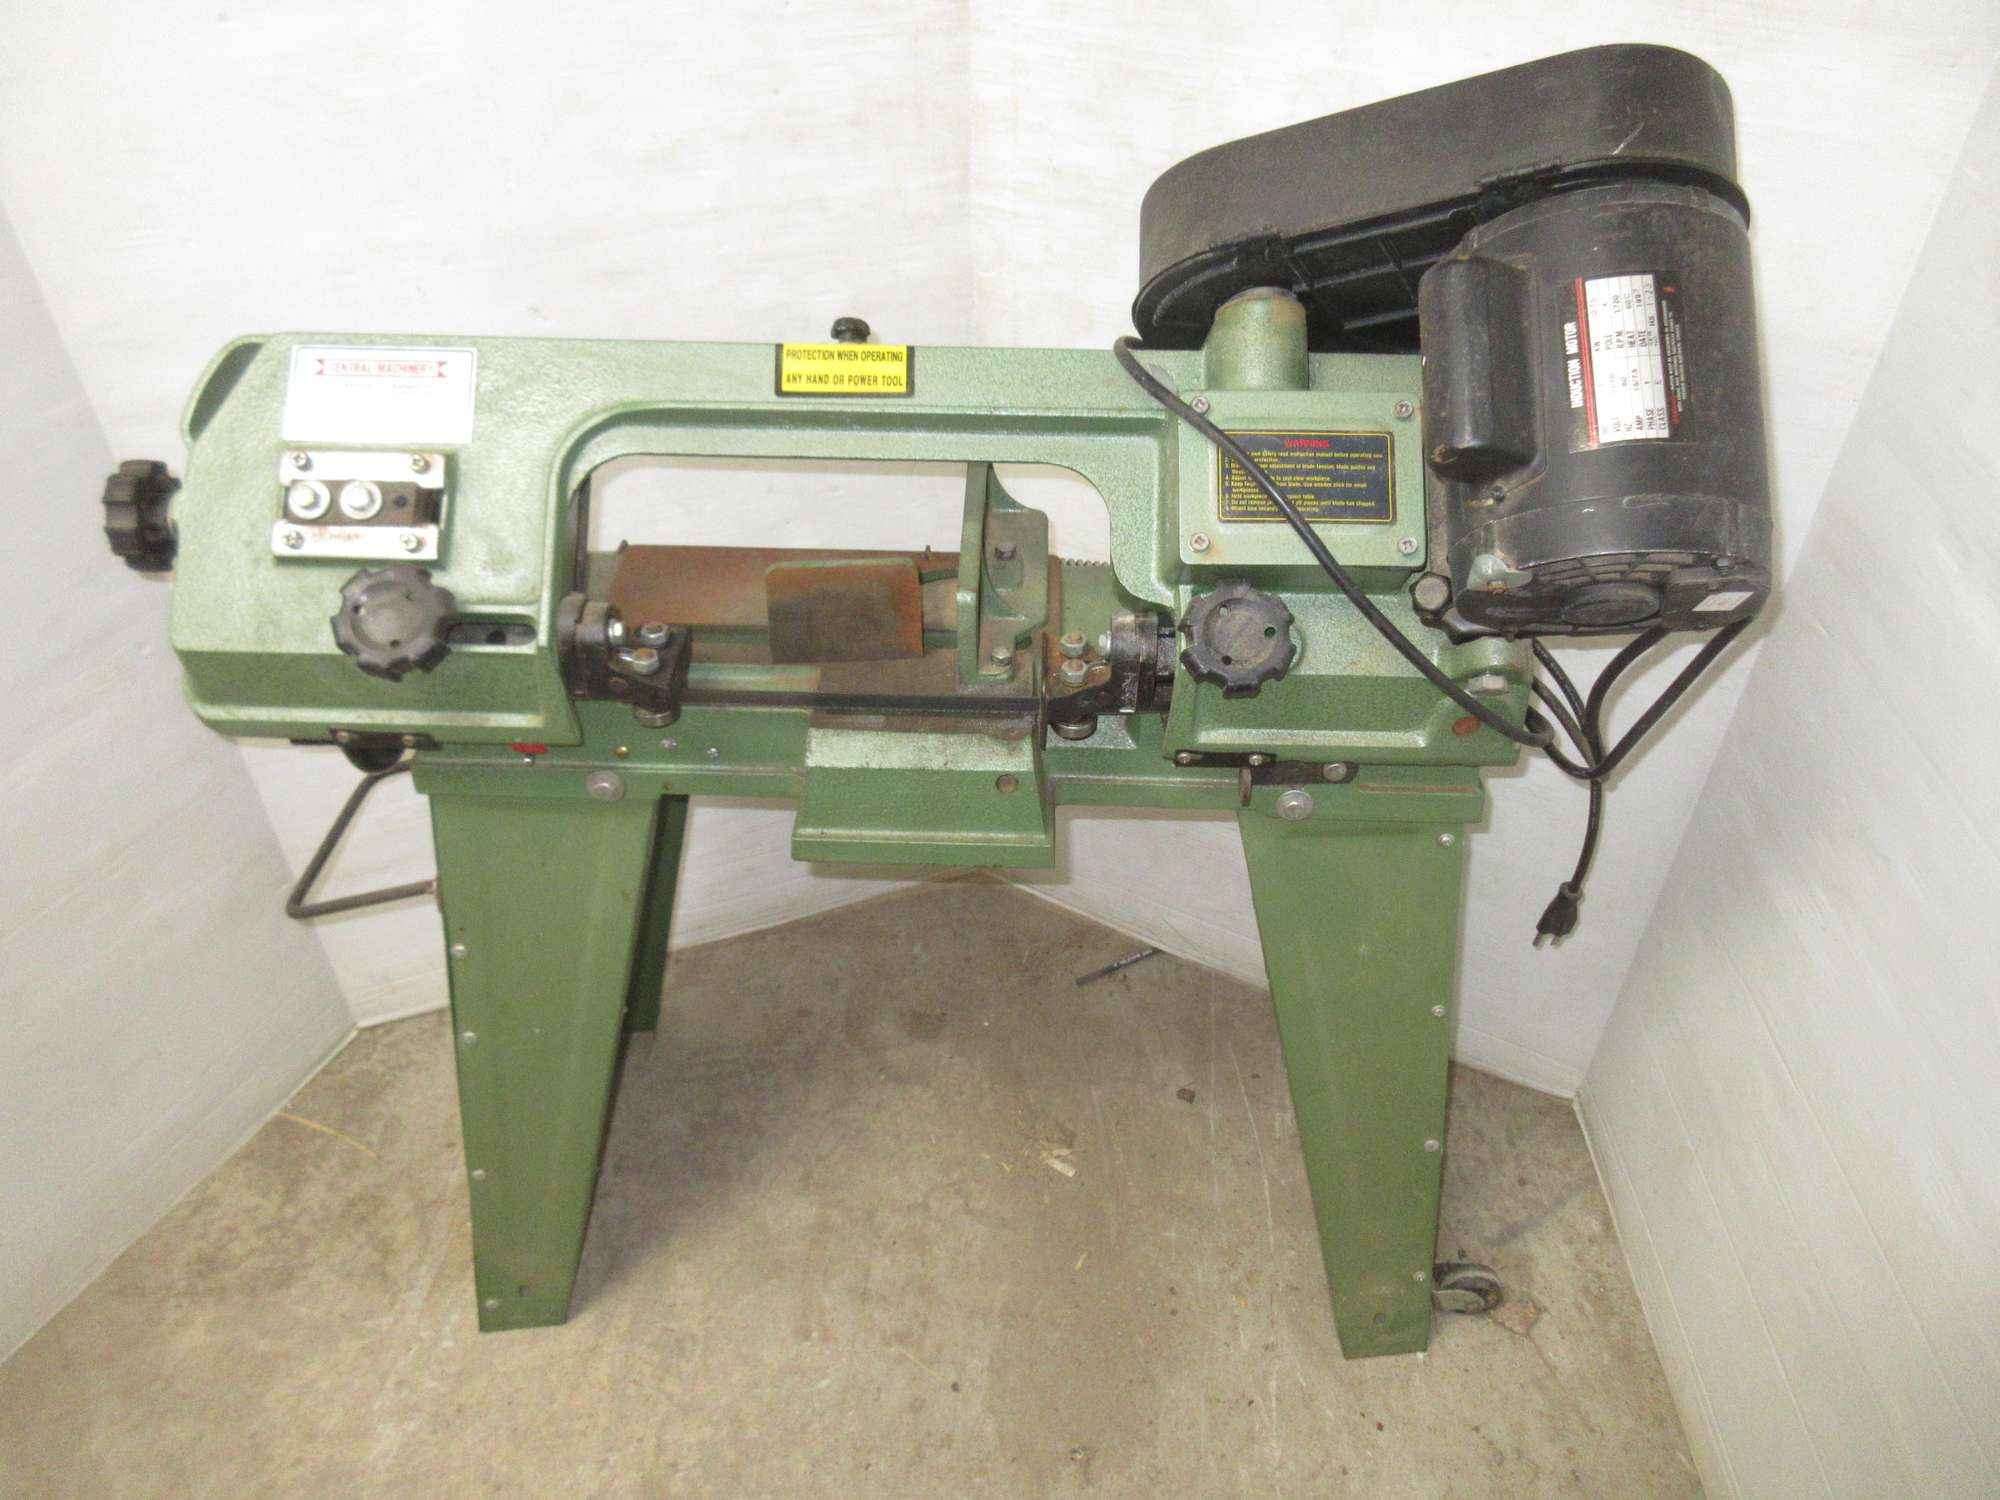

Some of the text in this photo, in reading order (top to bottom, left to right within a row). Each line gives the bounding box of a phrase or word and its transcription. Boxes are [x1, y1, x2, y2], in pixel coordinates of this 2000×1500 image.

[1628, 330, 1636, 348] HEAT
[1637, 329, 1647, 348] DATE
[785, 349, 903, 362] PROTECTION WHEN OPERATING
[1564, 321, 1583, 409] INDUCTION MOTOR
[785, 373, 903, 387] ANY HAND OR POWER TOOL
[1635, 415, 1645, 431] AMP
[1646, 407, 1656, 431] PHASE
[1656, 407, 1667, 431] CLASS
